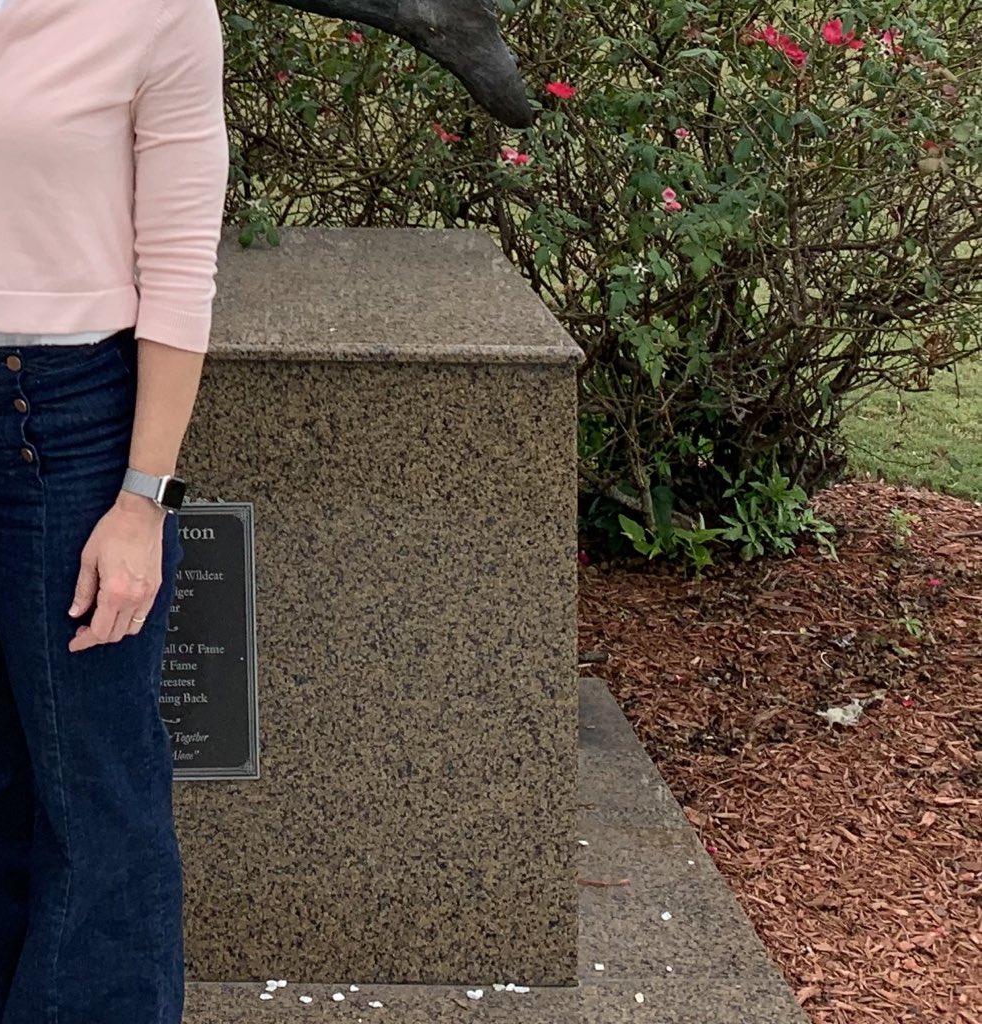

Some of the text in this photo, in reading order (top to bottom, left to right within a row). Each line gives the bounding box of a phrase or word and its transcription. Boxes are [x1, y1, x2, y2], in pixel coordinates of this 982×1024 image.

[178, 525, 215, 540] ton
[185, 570, 224, 580] Wildcat
[175, 586, 194, 599] iger
[162, 643, 225, 654] all Of Fame
[170, 661, 198, 671] Fame
[160, 679, 195, 687] reatest
[158, 693, 208, 706] ning Back
[174, 732, 209, 745] Together
